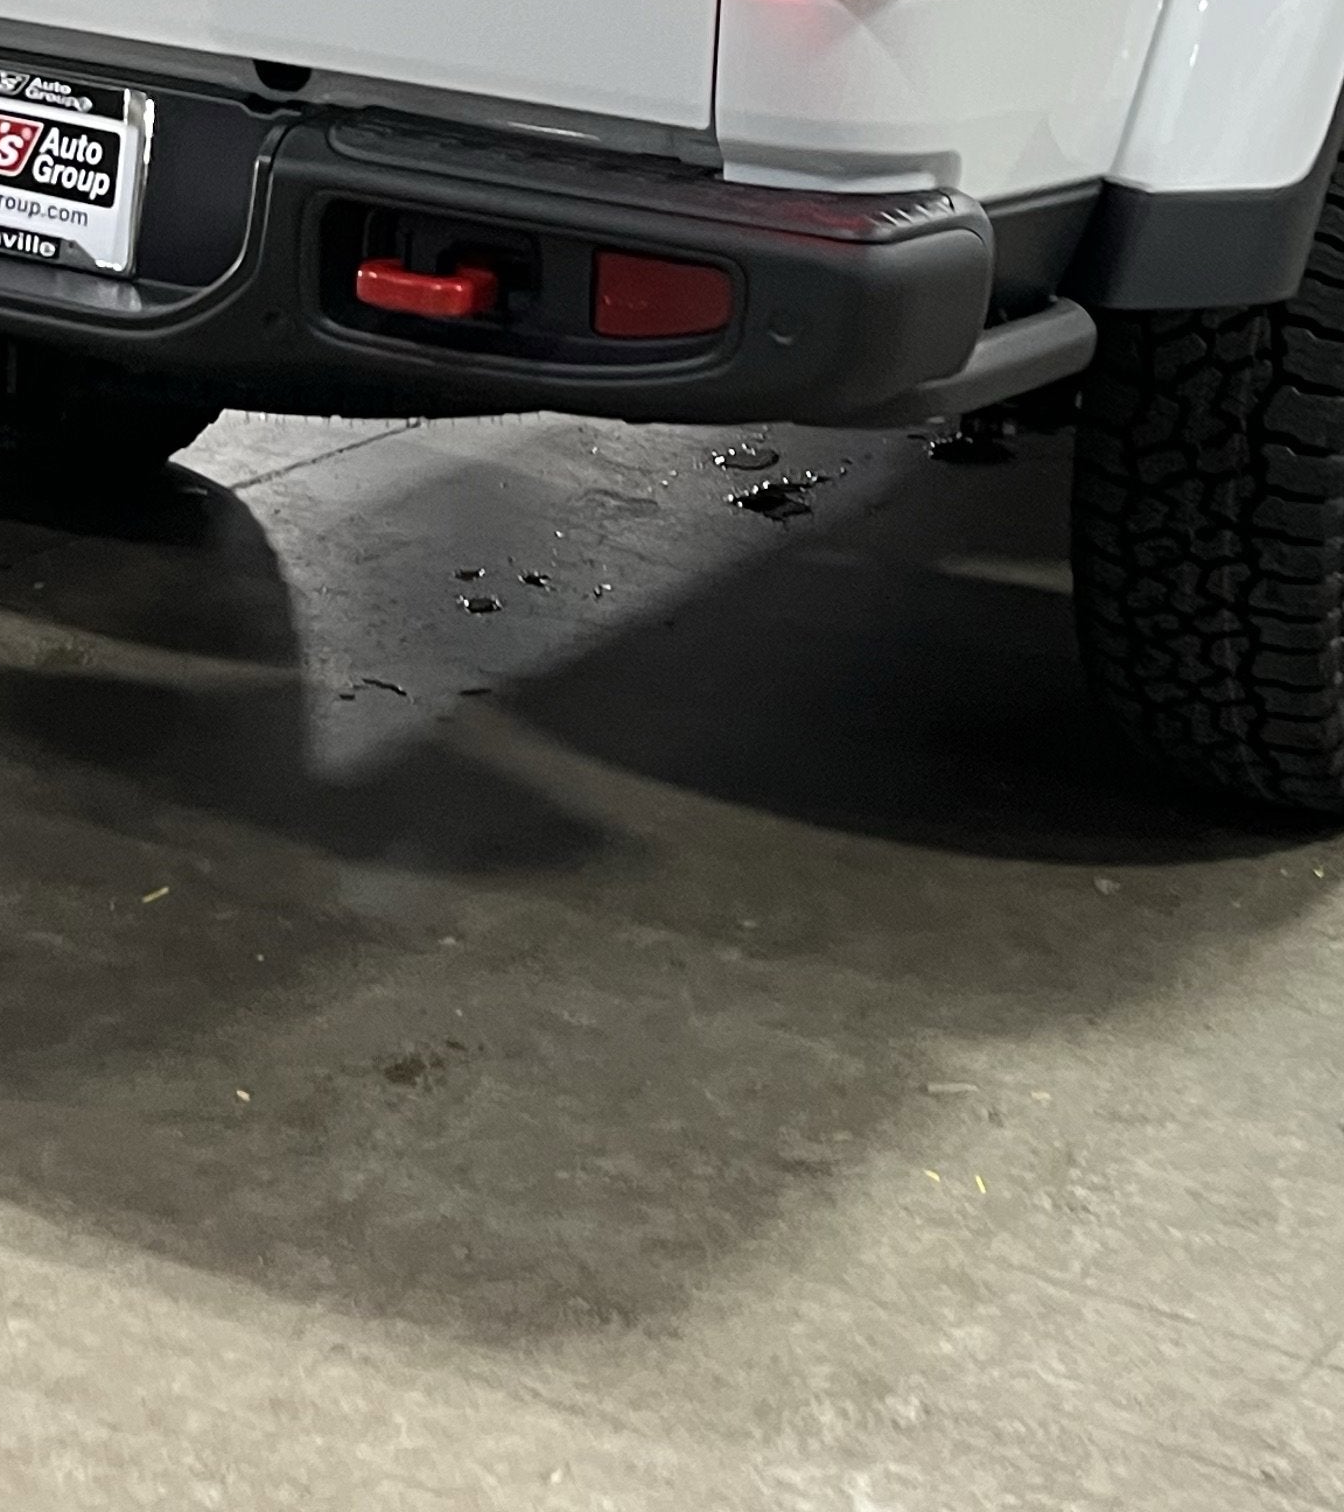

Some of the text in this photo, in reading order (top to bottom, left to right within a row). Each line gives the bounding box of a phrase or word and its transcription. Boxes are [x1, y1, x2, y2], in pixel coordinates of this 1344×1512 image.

[29, 77, 72, 95] Auto
[39, 127, 104, 166] Auto
[32, 154, 111, 200] Group
